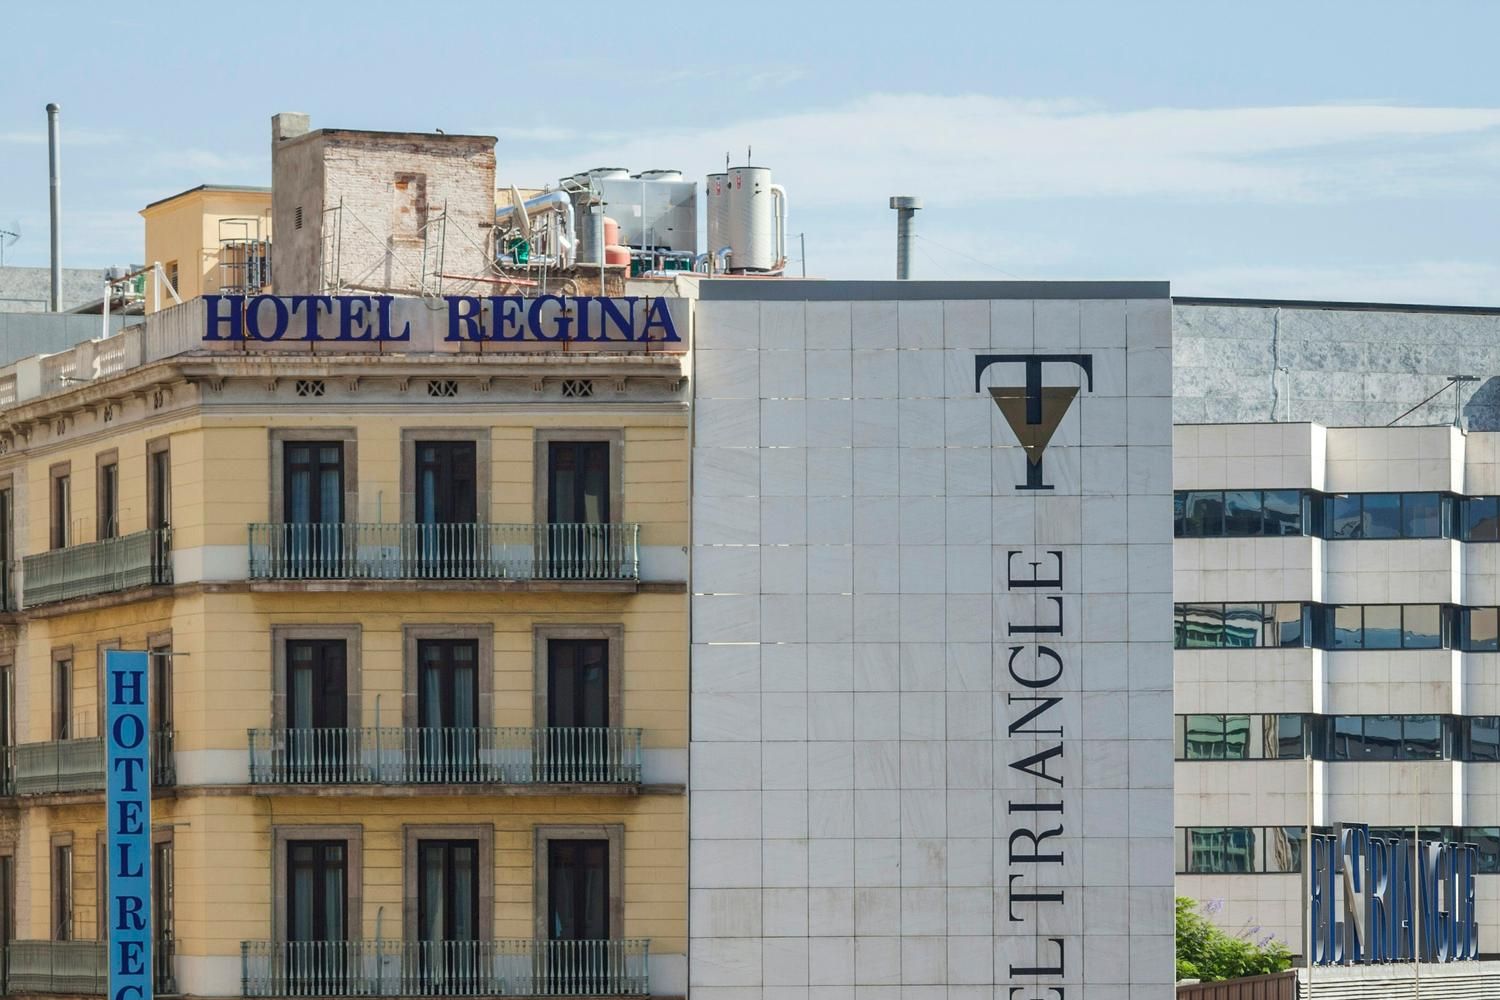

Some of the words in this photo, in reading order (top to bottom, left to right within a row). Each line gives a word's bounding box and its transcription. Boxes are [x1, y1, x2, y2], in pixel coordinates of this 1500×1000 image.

[202, 294, 411, 342] HOTEL
[443, 294, 681, 343] REGINA
[112, 670, 145, 879] HOTEL
[1008, 549, 1065, 922] TRIANGLE
